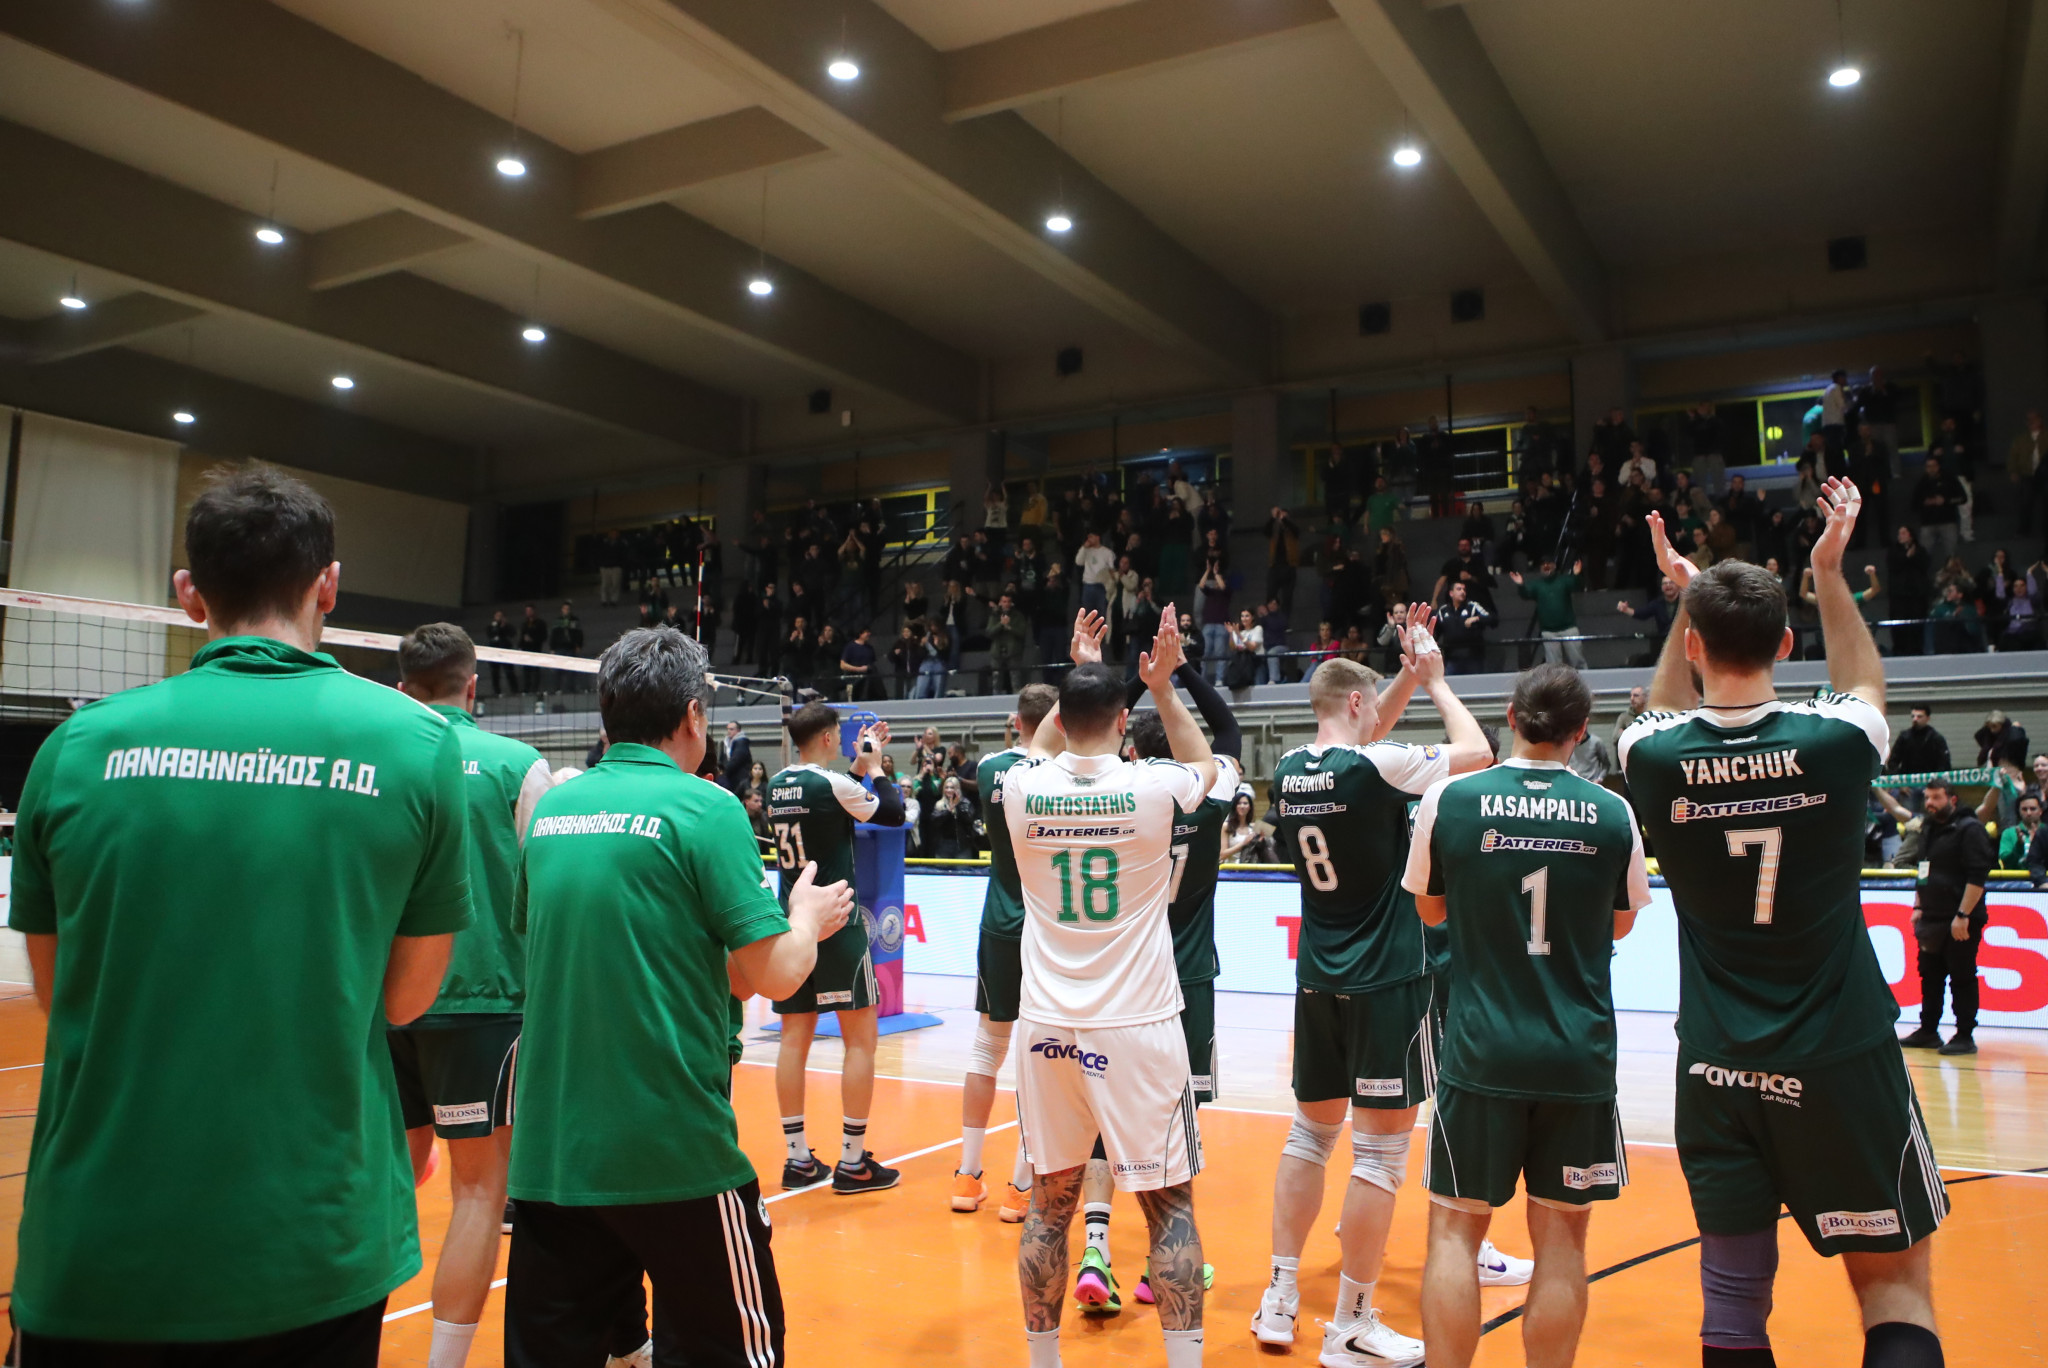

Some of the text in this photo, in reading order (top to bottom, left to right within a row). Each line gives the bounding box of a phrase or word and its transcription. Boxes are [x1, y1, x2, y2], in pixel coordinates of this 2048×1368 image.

[1679, 748, 1804, 786] YANCHUK
[771, 786, 803, 801] SPIRITO
[1025, 792, 1137, 816] KONTOSTATHIS
[1283, 802, 1347, 816] BATTERIES.GR
[1480, 794, 1598, 825] KASAMPALIS
[1683, 794, 1827, 819] BATTERIES.GR
[1035, 824, 1136, 838] BATTERIES.GR
[774, 821, 809, 870] 31
[1491, 834, 1597, 854] BATTERIES.GR
[1297, 825, 1339, 892] 8
[1051, 846, 1121, 923] 18
[1723, 826, 1783, 925] 7
[1521, 865, 1551, 956] 1
[1360, 1081, 1402, 1091] BOLOSSIS
[1704, 1065, 1804, 1098] avance
[1761, 1093, 1802, 1108] CAR RENTAL
[1828, 1216, 1895, 1228] BOLOSSIS
